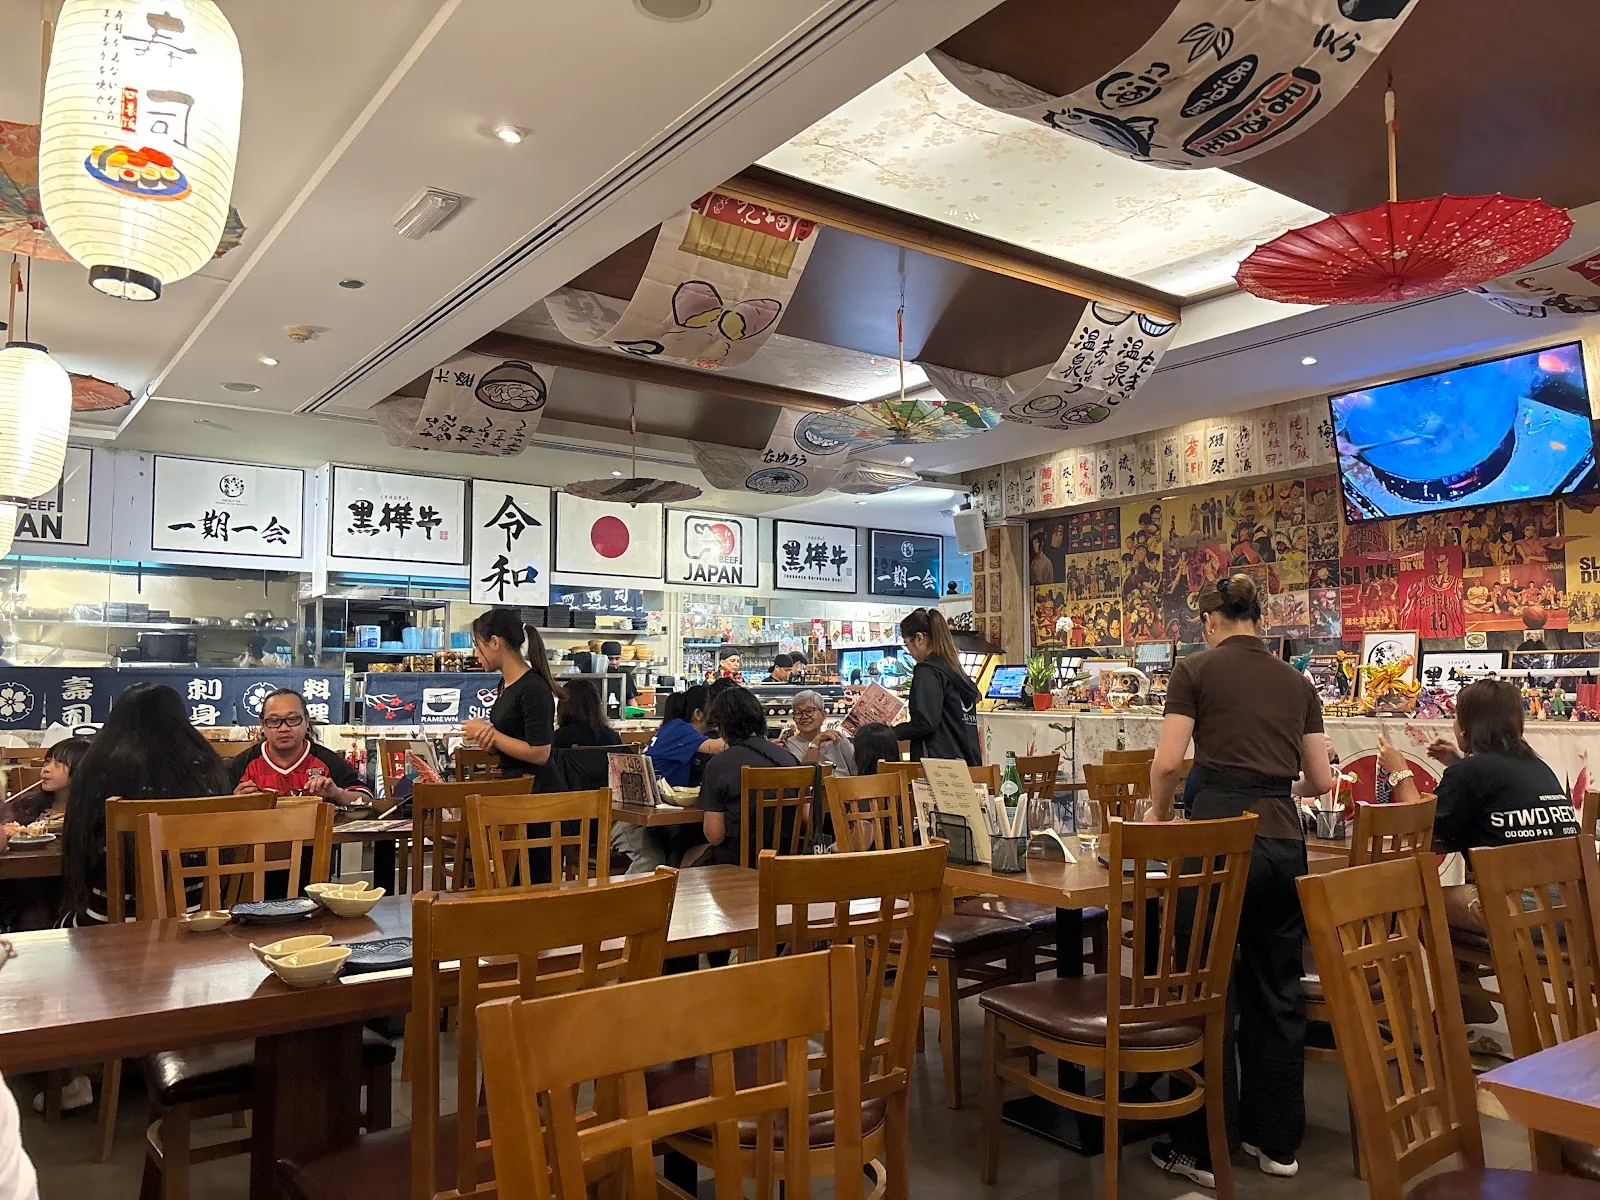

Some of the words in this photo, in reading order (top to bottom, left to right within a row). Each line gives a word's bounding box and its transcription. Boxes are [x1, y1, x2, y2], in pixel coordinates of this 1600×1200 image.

[763, 448, 808, 468] なめろう
[167, 508, 291, 545] 一期一会
[347, 500, 443, 541] 黒樺牛
[481, 494, 543, 602] 令和
[719, 555, 739, 565] BEEF
[781, 540, 849, 577] 黒樺牛
[682, 562, 743, 584] JAPAN
[876, 565, 937, 590] 一期一会
[1430, 611, 1449, 631] 10
[187, 678, 222, 726] 刺身
[303, 678, 331, 724] 料理
[1490, 807, 1549, 828] STWD
